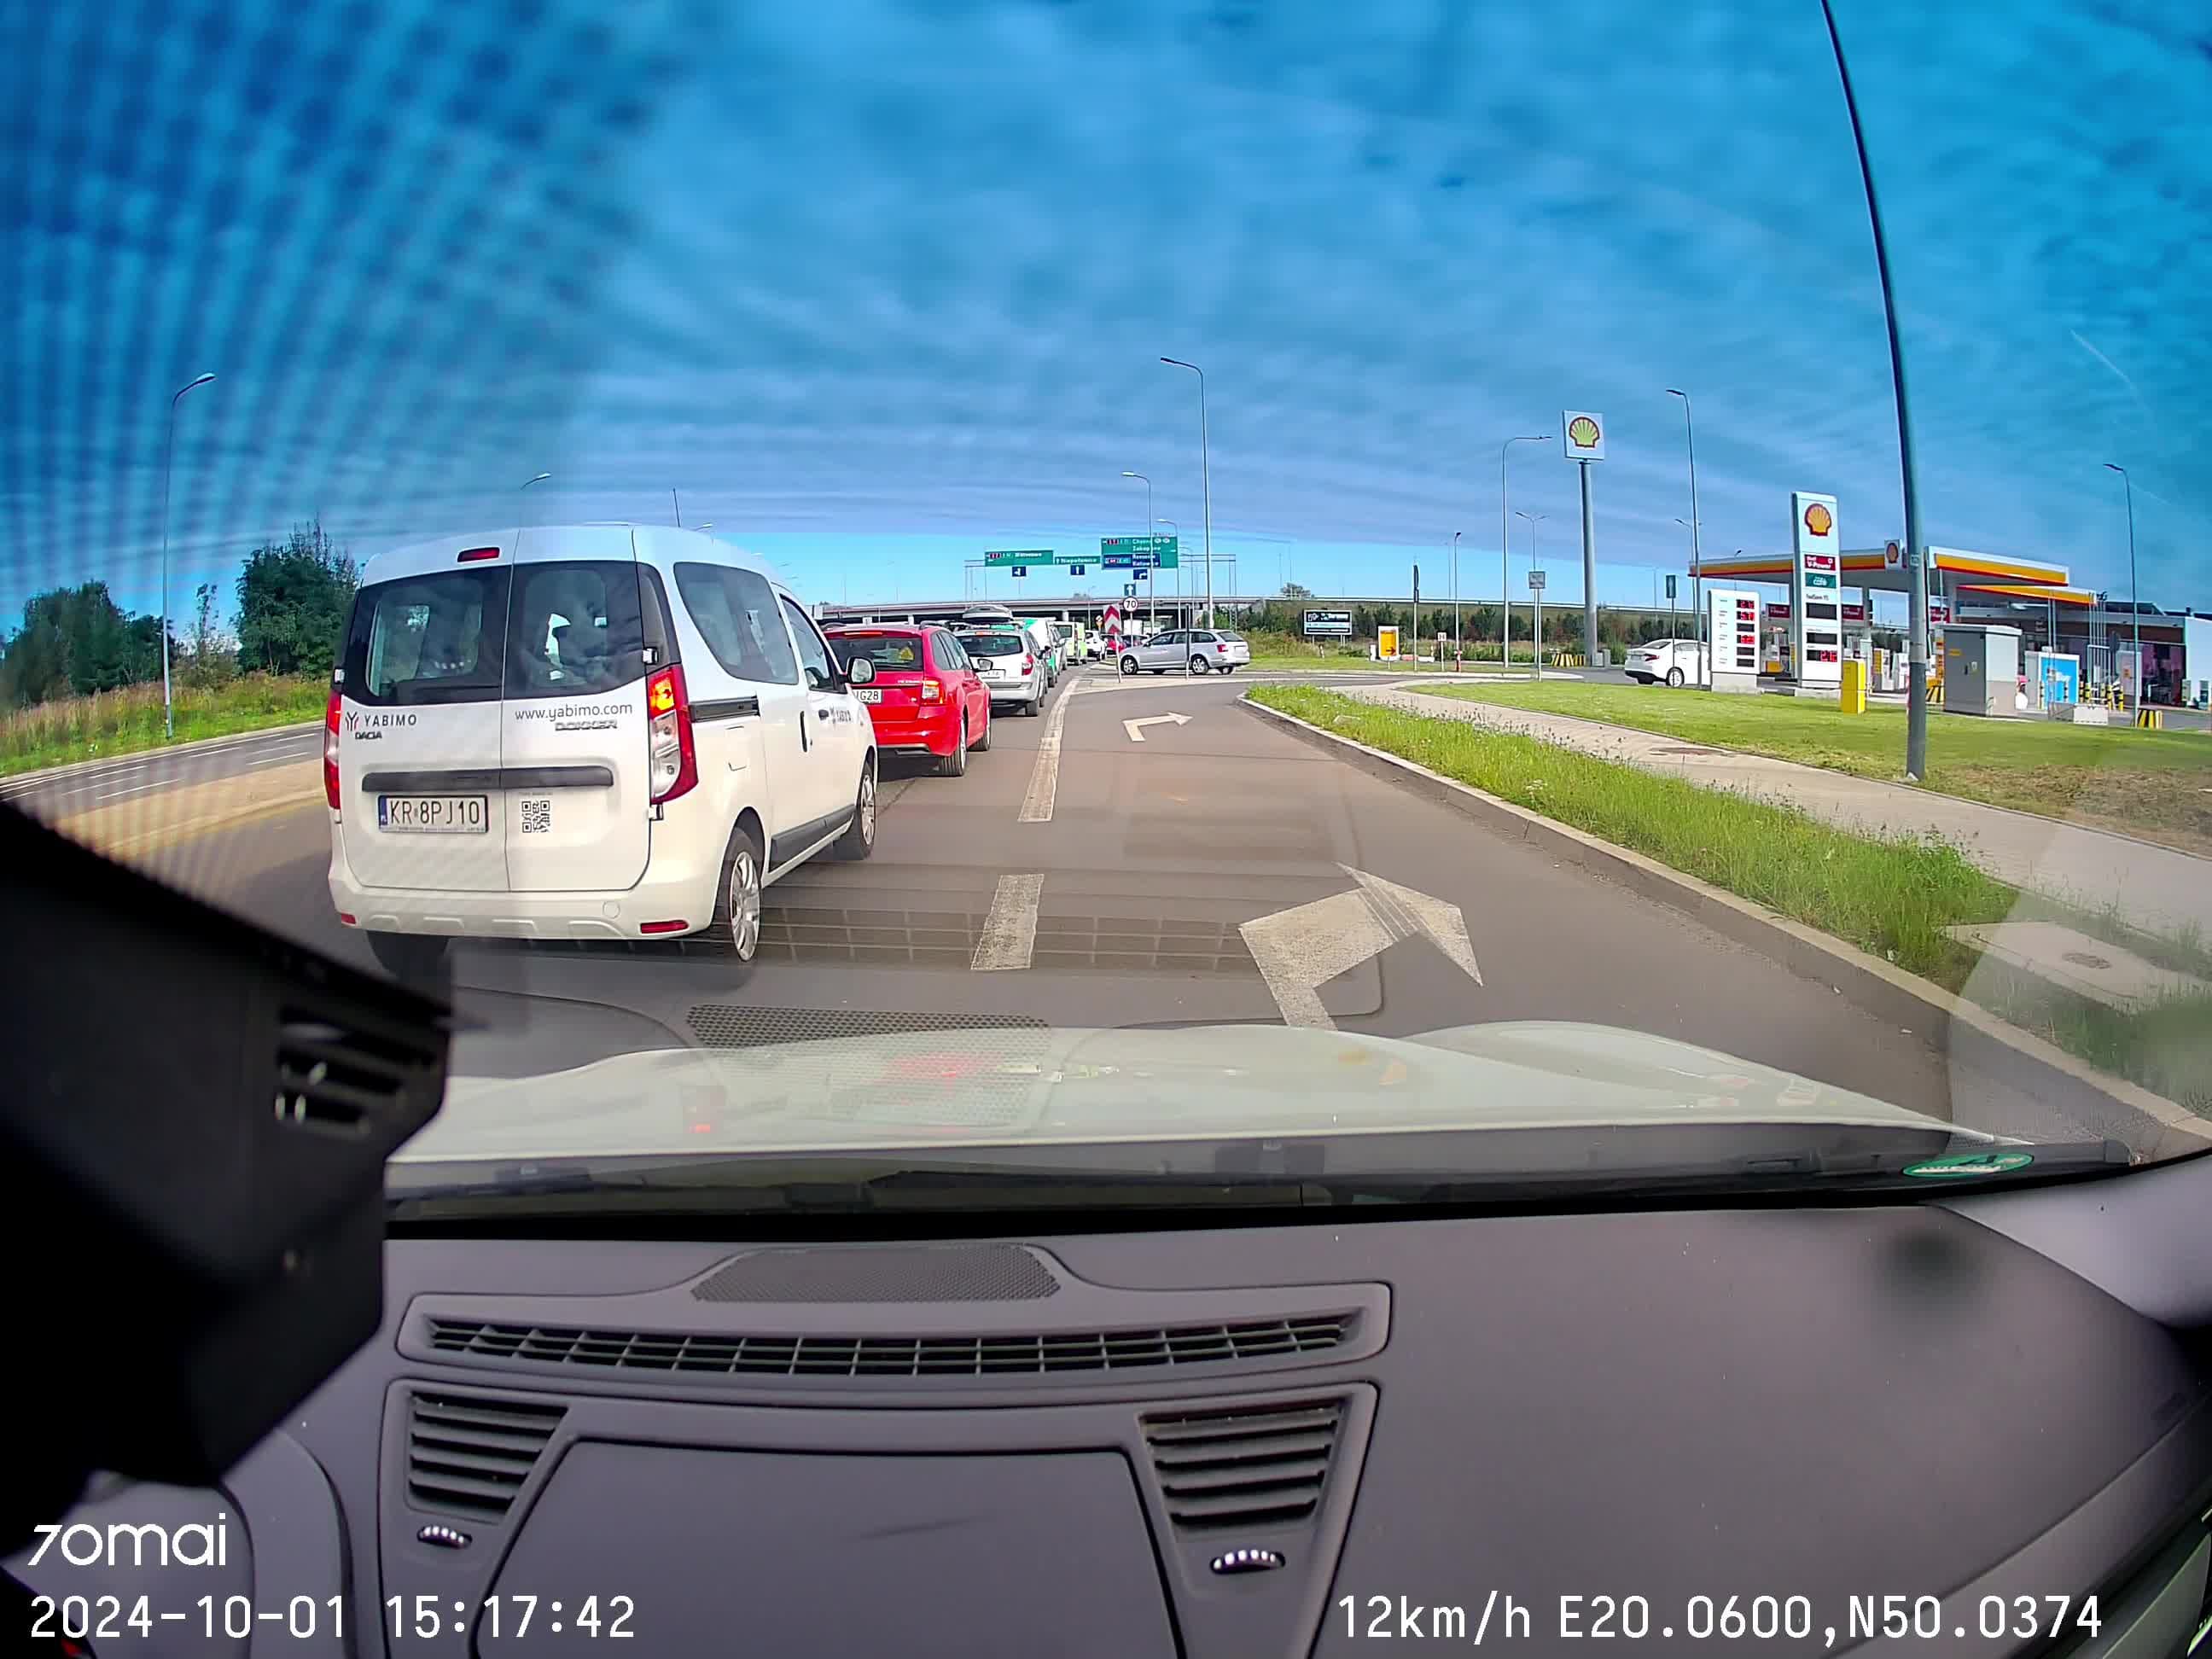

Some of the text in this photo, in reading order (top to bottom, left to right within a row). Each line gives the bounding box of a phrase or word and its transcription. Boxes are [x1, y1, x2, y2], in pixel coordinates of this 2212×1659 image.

[1126, 600, 1137, 608] 70
[515, 703, 633, 722] www.yabimo.com
[364, 713, 417, 727] YABIMO
[354, 731, 383, 740] DACIA
[390, 800, 480, 825] KR 8PJ10
